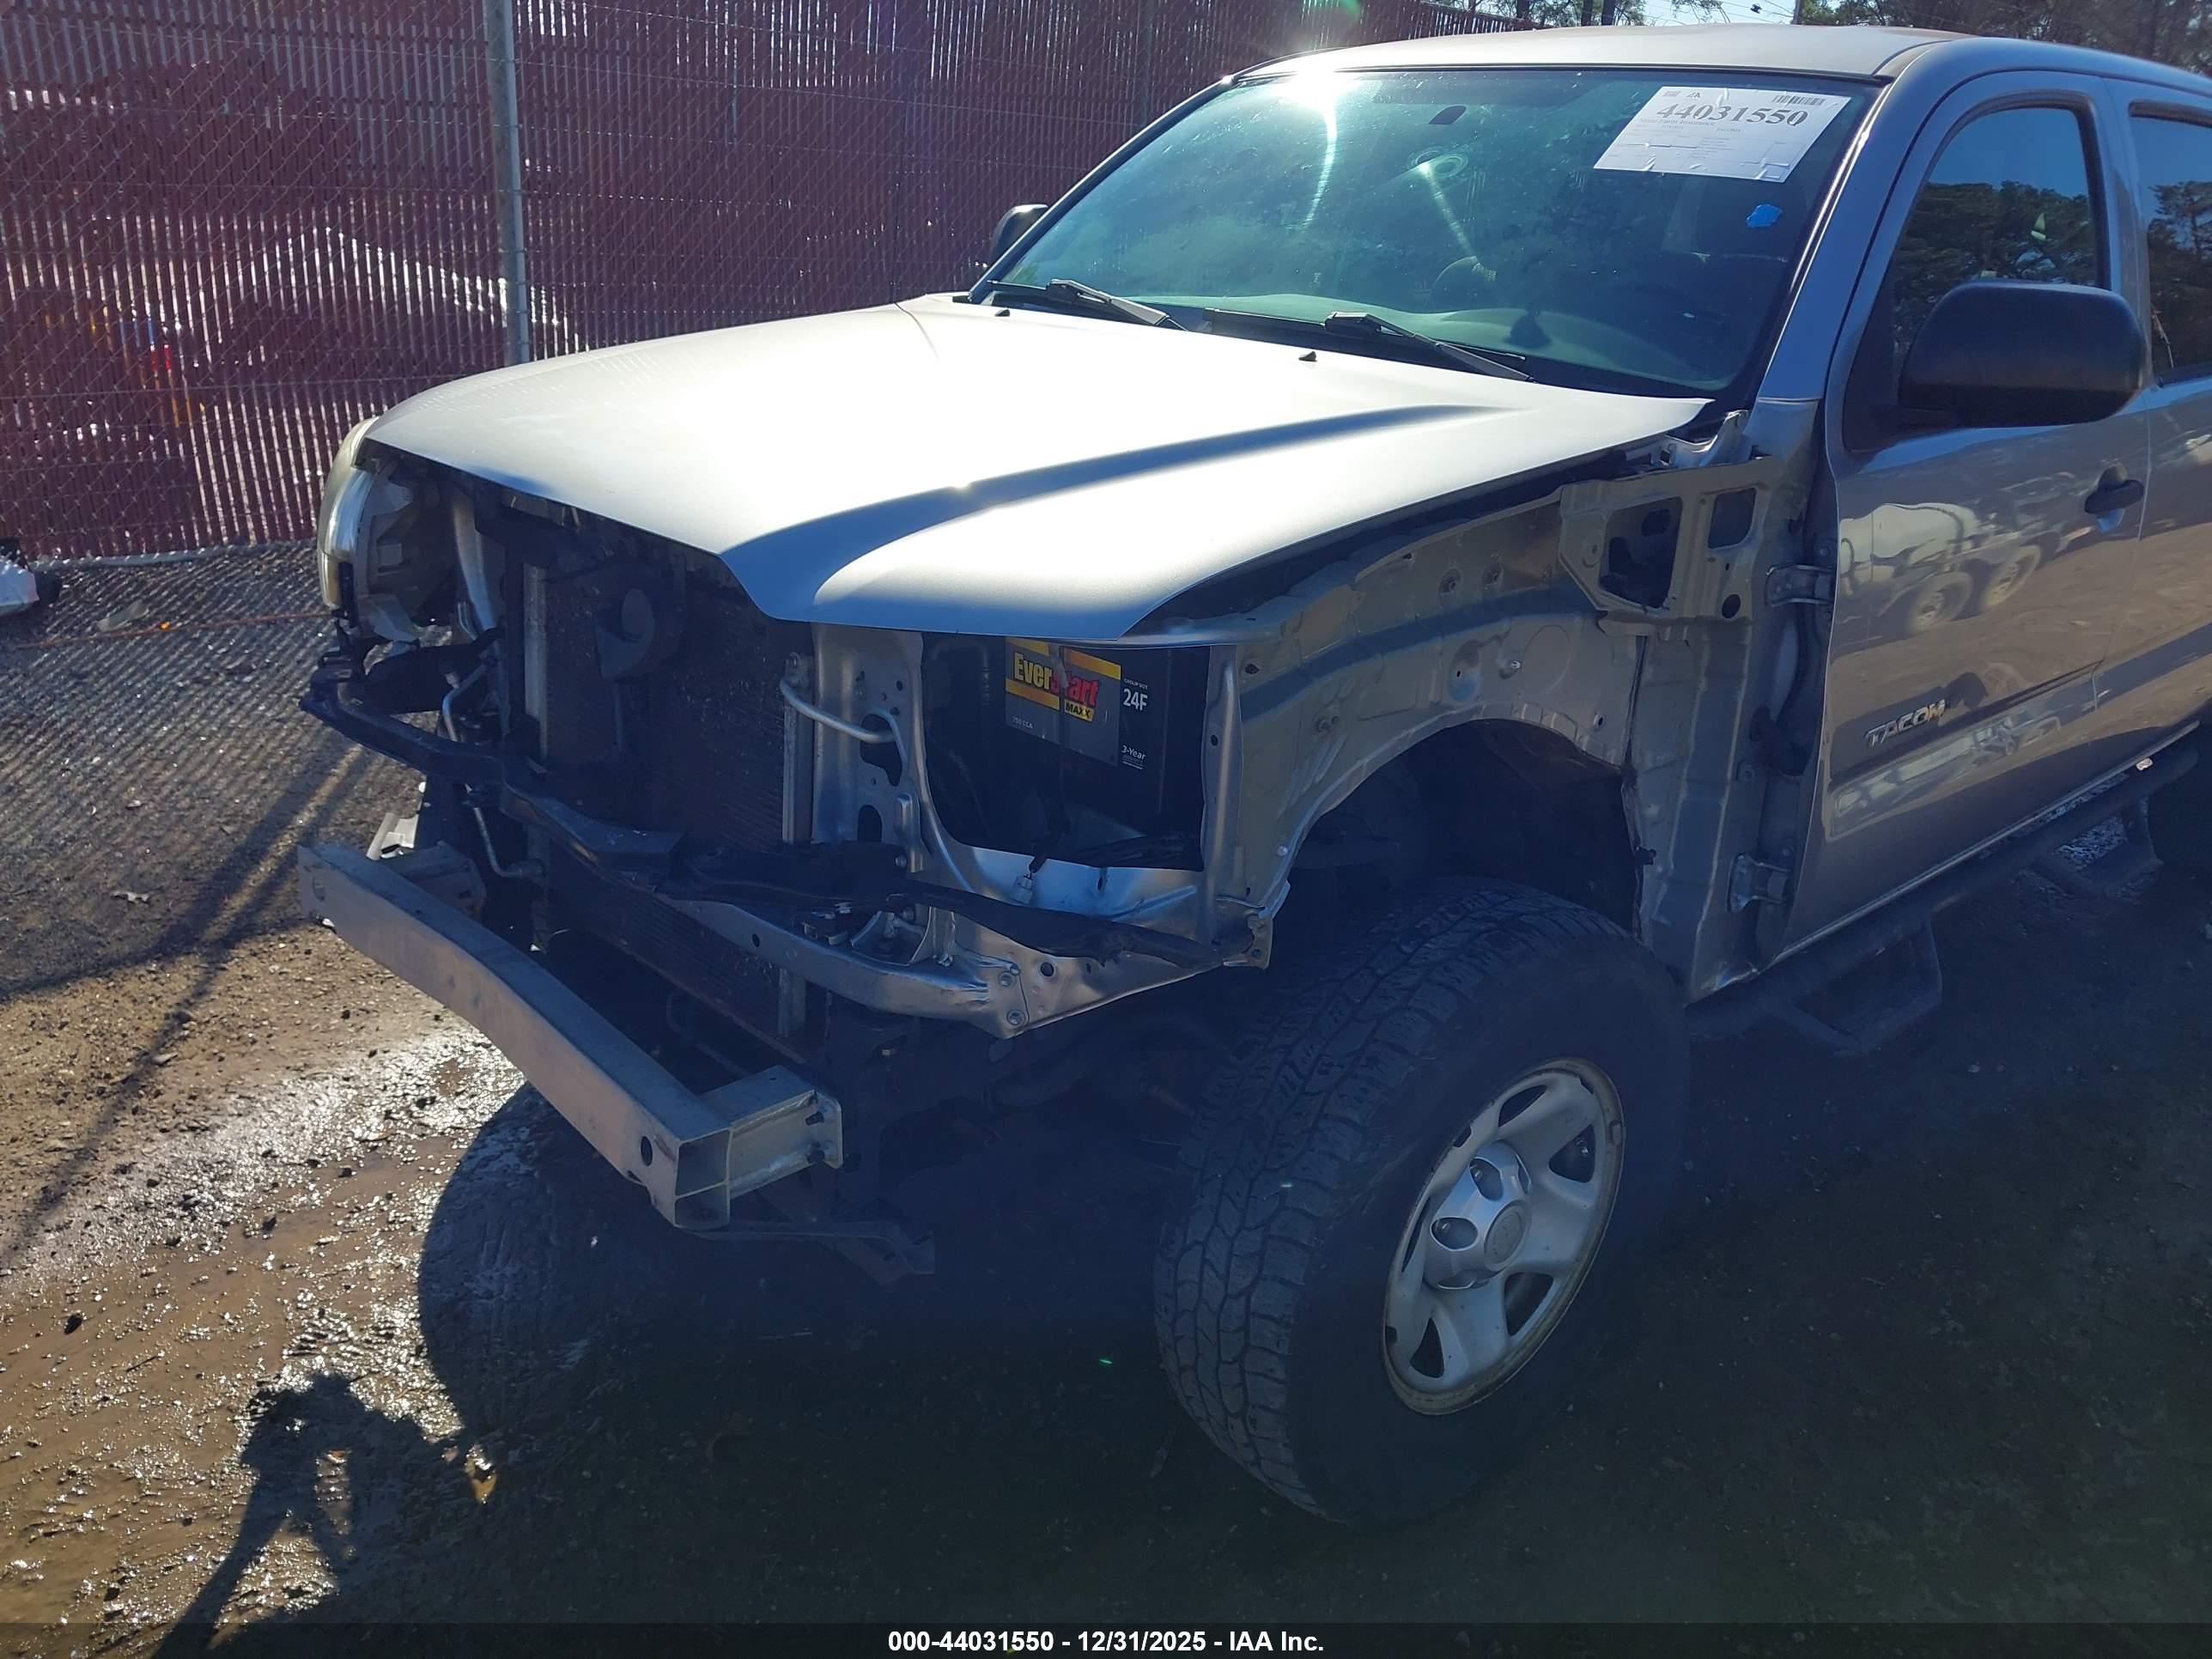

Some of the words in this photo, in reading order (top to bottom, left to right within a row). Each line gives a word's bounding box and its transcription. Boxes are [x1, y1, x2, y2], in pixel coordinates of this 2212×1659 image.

[1657, 103, 1808, 127] 44031550
[1122, 688, 1148, 711] 24F
[1065, 701, 1091, 719] MAXX
[1121, 744, 1146, 761] 3-Year
